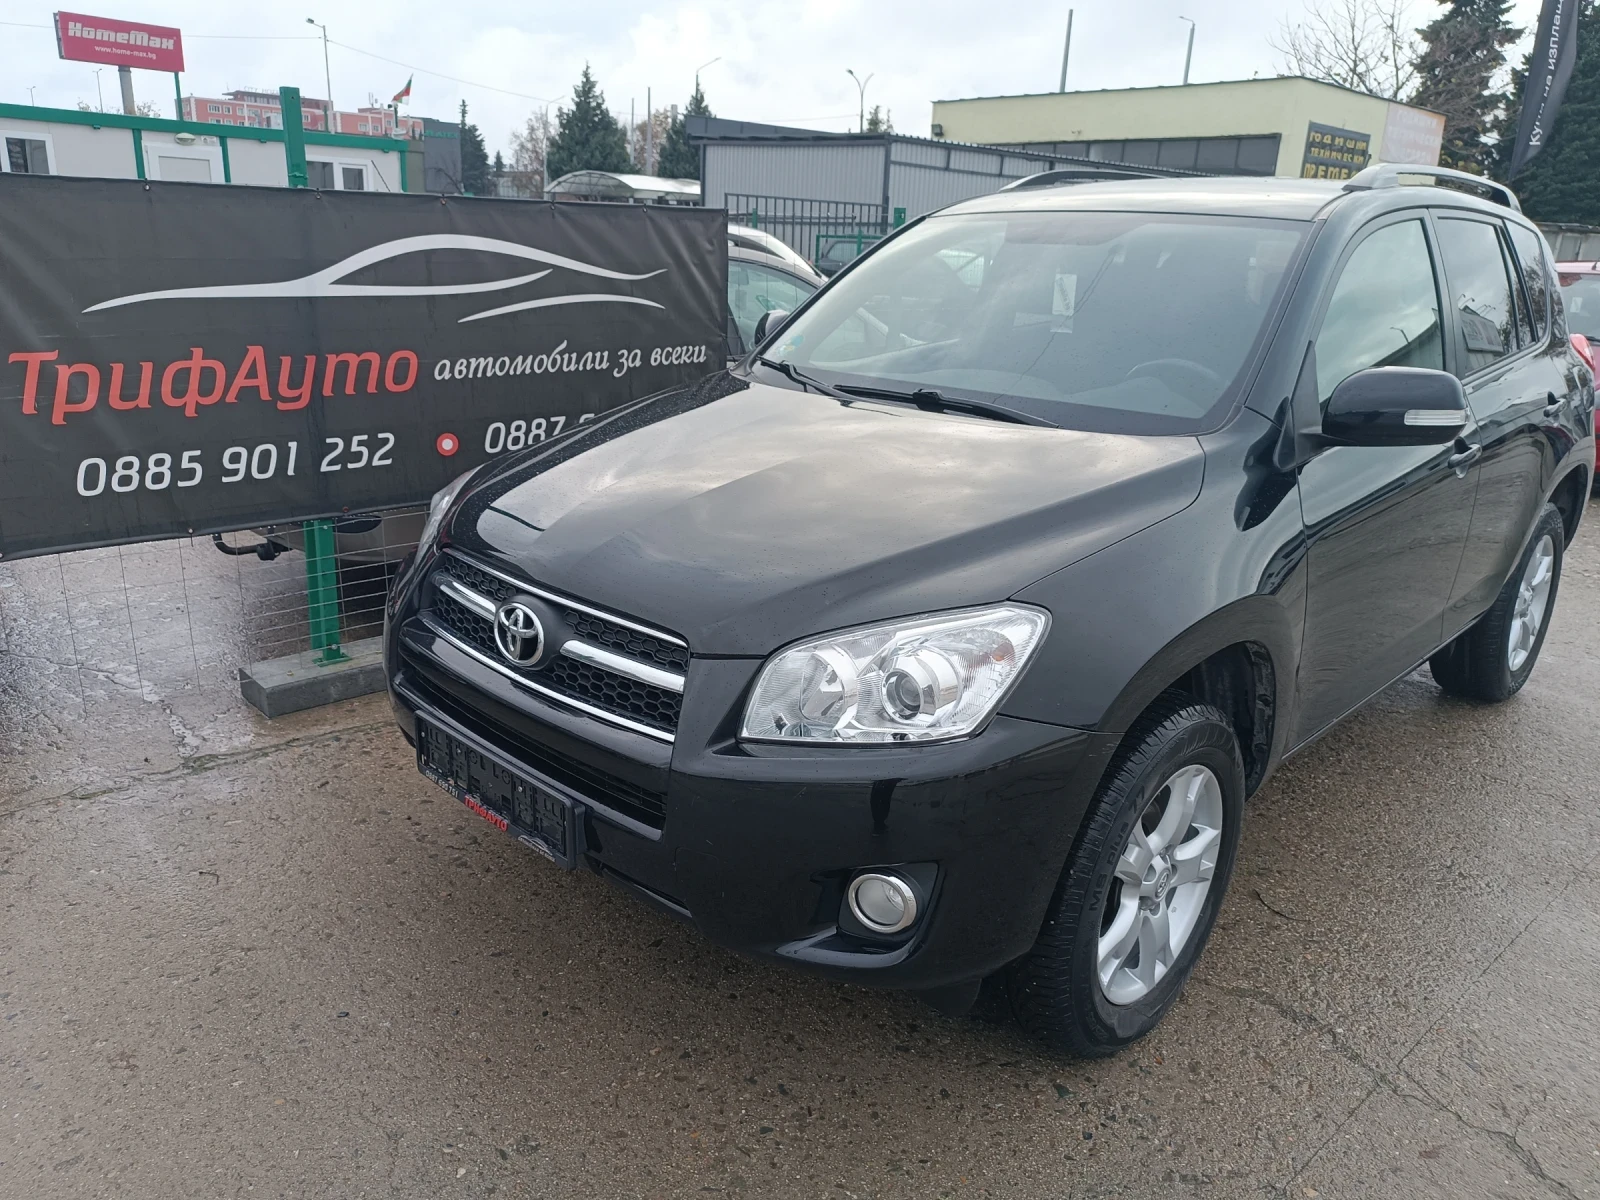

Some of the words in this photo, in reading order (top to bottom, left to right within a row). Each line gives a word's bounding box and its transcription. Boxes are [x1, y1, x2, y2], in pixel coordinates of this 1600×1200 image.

[68, 21, 175, 50] HomeMax
[94, 45, 157, 60] www.home-max.bg
[1529, 103, 1545, 146] Ку
[8, 345, 418, 425] ТрифАуто
[434, 340, 610, 381] автомобили
[613, 348, 642, 378] за
[650, 344, 707, 367] всеки
[77, 450, 203, 497] 0885
[221, 441, 298, 483] 901
[320, 432, 395, 472] 252
[484, 416, 566, 453] 0887
[1107, 822, 1129, 866] plus
